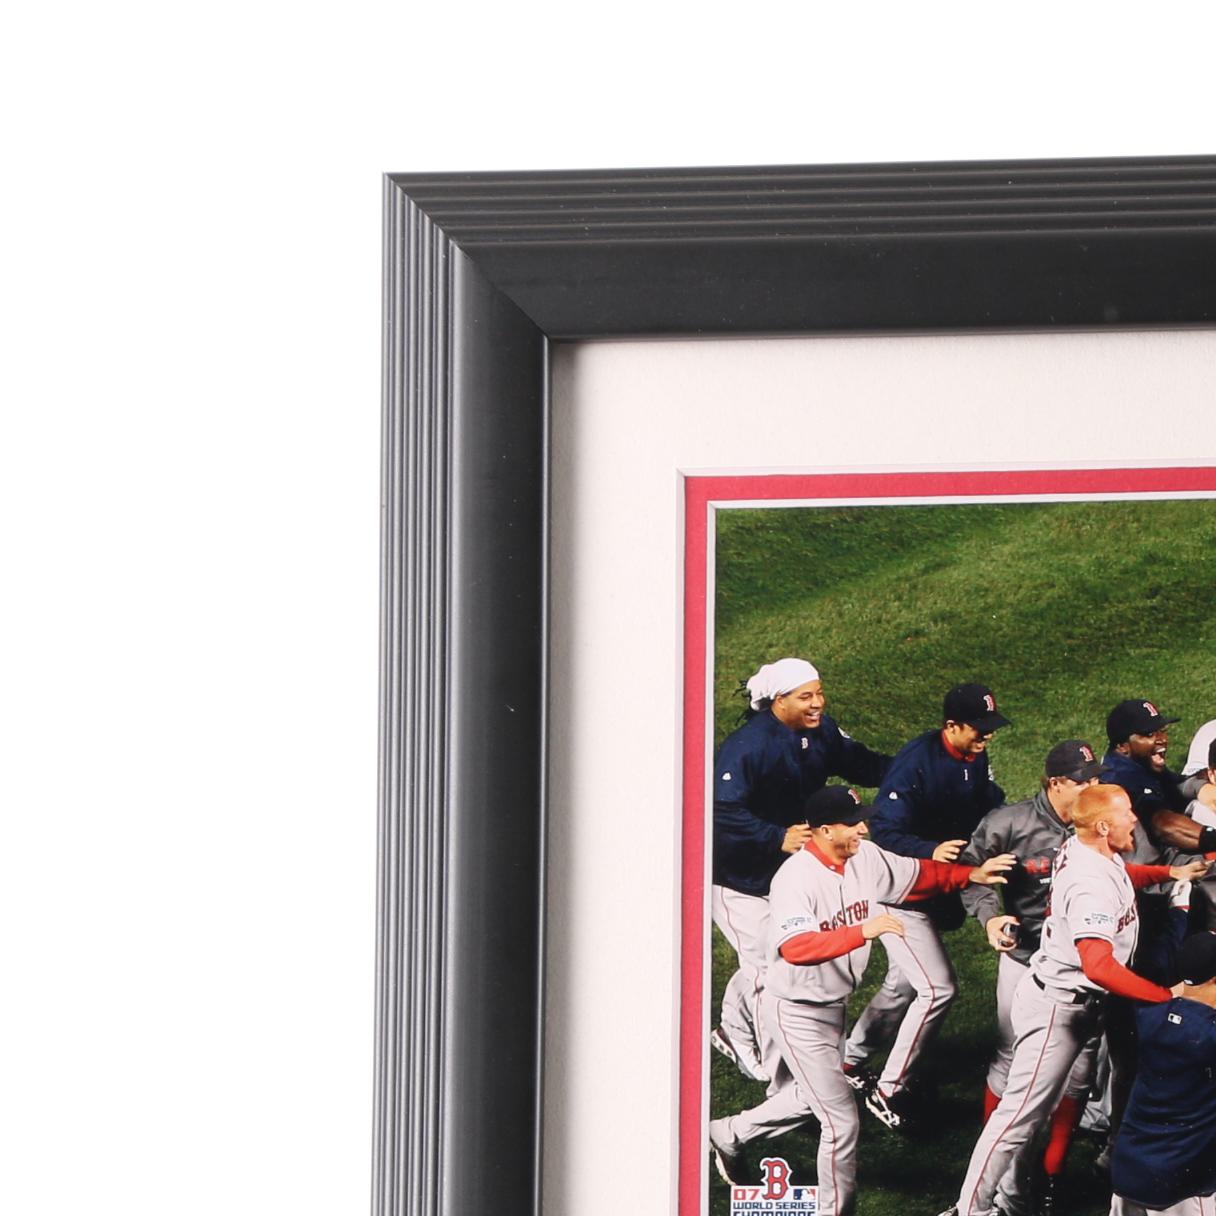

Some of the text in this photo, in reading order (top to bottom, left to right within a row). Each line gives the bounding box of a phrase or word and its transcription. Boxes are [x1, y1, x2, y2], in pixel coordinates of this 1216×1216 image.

[761, 1158, 792, 1200] B
[733, 1188, 761, 1201] 07
[732, 1201, 816, 1210] WORLD SERIES
